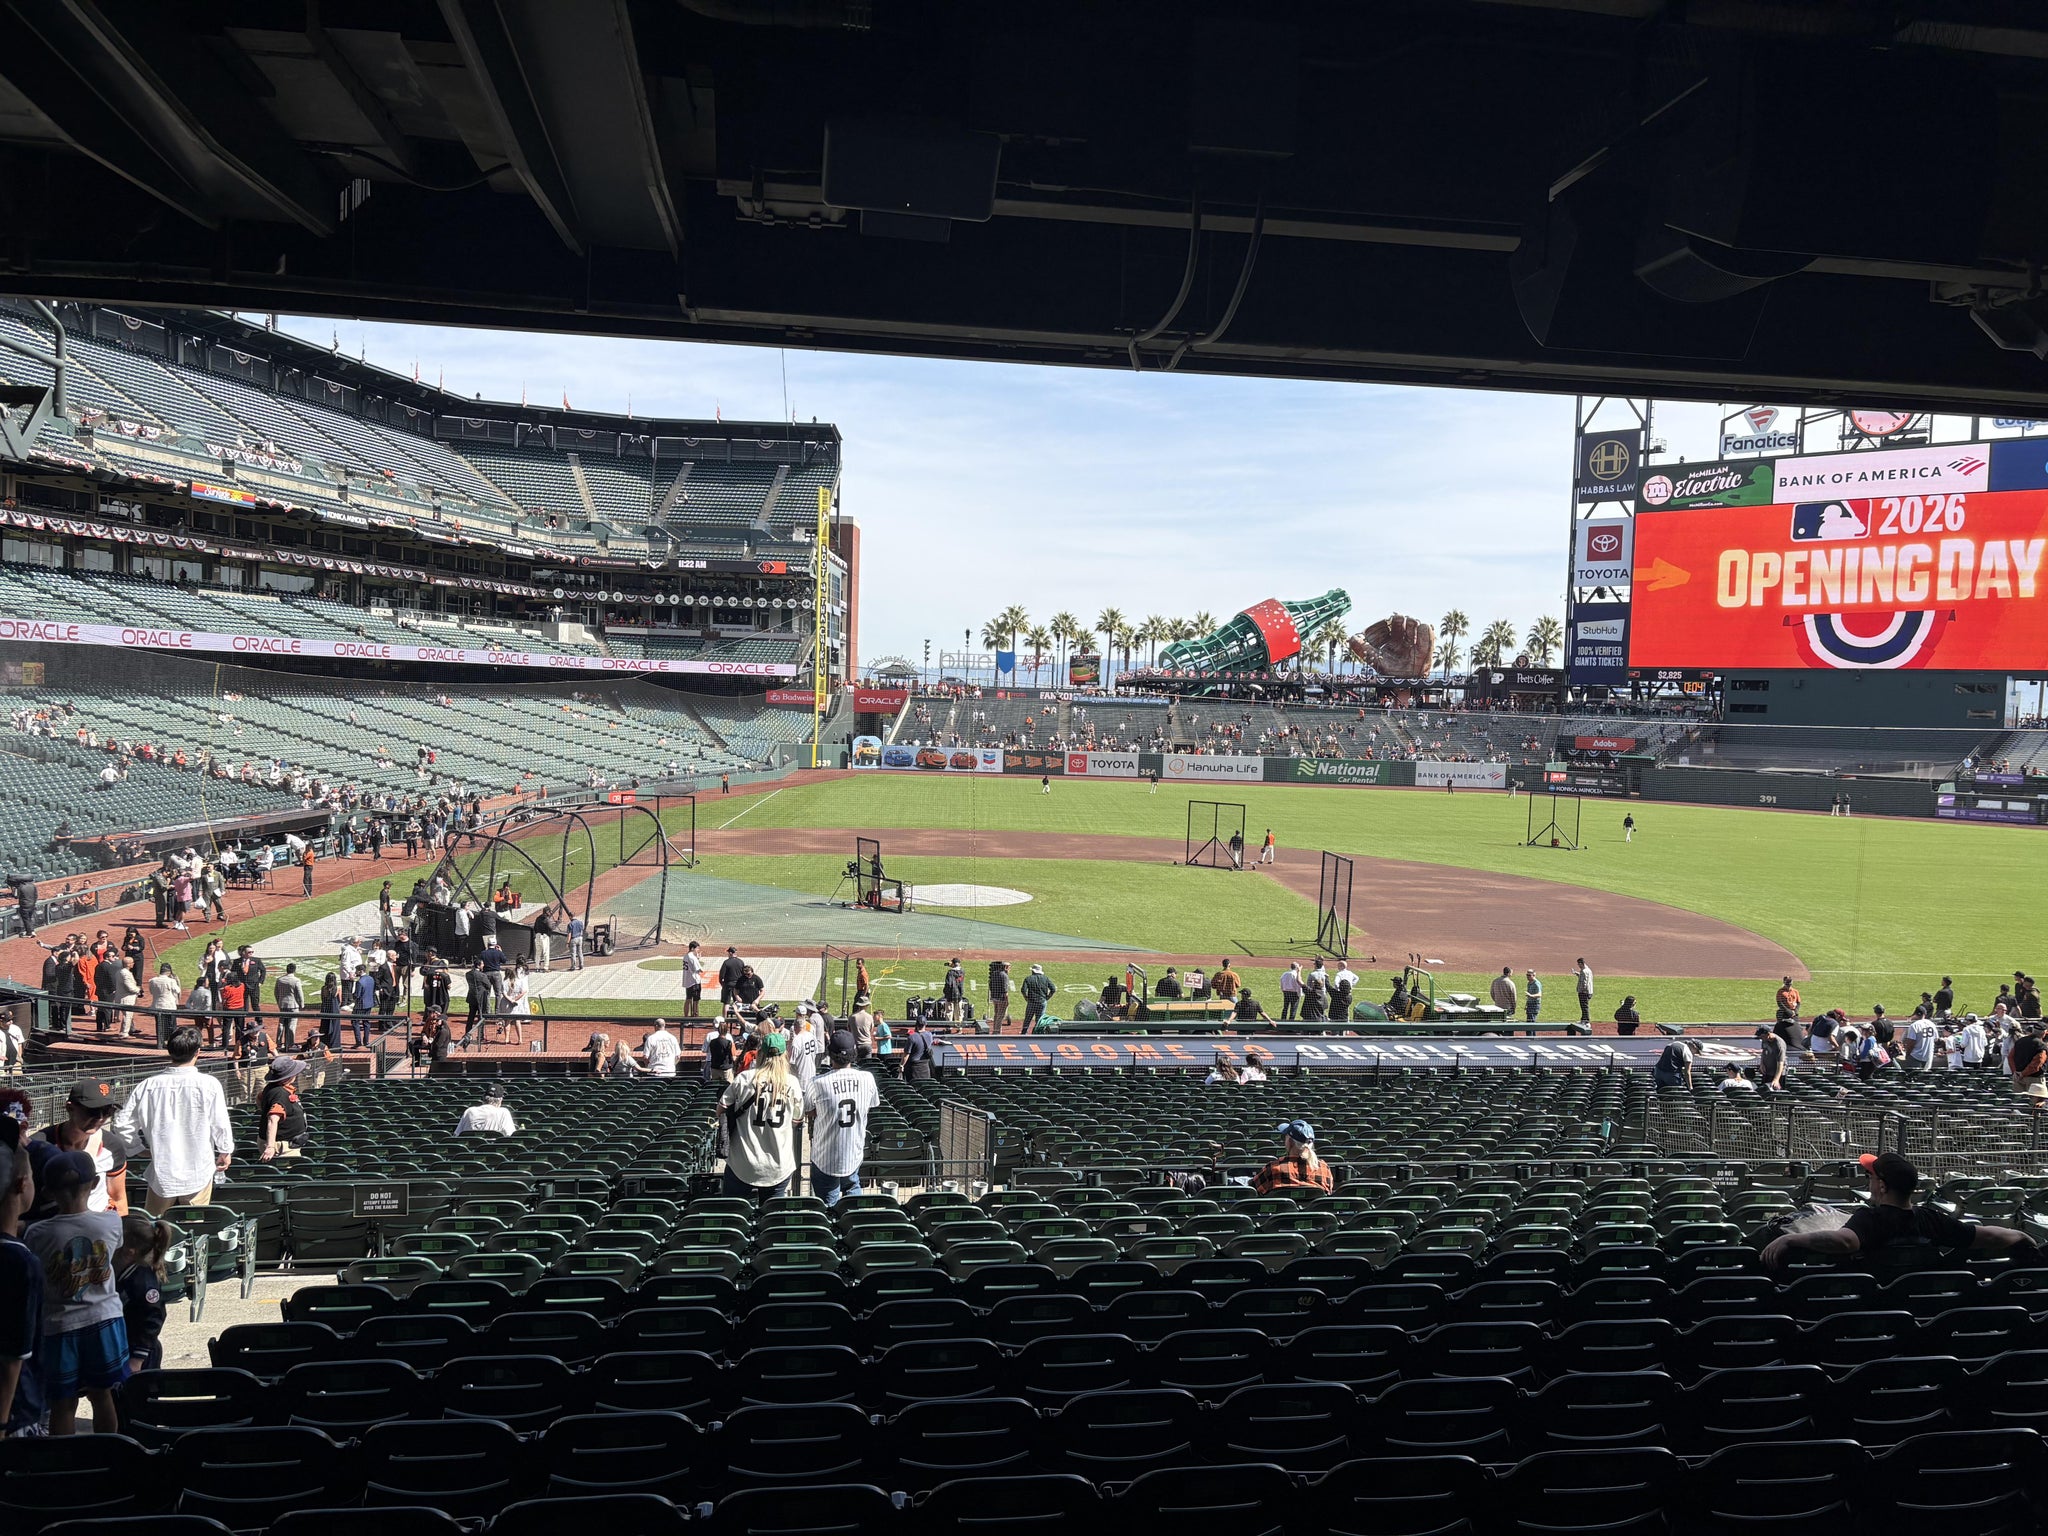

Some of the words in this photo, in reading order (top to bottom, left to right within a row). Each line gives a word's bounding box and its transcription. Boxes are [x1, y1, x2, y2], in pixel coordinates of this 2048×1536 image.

[1723, 433, 1795, 451] Fanatics
[1688, 466, 1729, 479] McMILLAN
[1779, 473, 1826, 487] BANK
[1831, 472, 1853, 484] OF
[1858, 466, 1942, 482] AMERICA
[1580, 484, 1615, 495] HABBAS
[1616, 483, 1636, 493] LAW
[1673, 471, 1743, 498] Electric
[1878, 494, 1966, 536] 2026
[695, 560, 707, 568] AM
[1577, 568, 1630, 580] TOYOTA
[1716, 543, 1933, 608] OPENING
[1937, 537, 2048, 600] DAY
[0, 621, 79, 641] ORACLE
[1583, 626, 1618, 635] StubHub
[121, 629, 192, 648] ORACLE
[233, 636, 301, 653] ORACLE
[334, 643, 391, 659] ORACLE
[417, 648, 465, 662] ORACLE
[1595, 646, 1622, 656] VERIFIED
[488, 652, 529, 665] ORACLE
[549, 655, 585, 668] ORACLE
[601, 659, 669, 671] ORACLE
[939, 650, 993, 669] blue
[1574, 657, 1597, 667] GIANTS
[1598, 656, 1624, 667] TICKETS
[708, 662, 775, 675] ORACLE
[1534, 674, 1554, 685] Coffee
[1657, 671, 1683, 680] $2,825
[782, 693, 816, 702] Budweise
[859, 697, 901, 705] ORACLE
[1593, 739, 1617, 748] Adobe
[1091, 760, 1135, 770] TOYOTA
[1187, 762, 1234, 773] Hanwha
[1236, 763, 1258, 774] Life
[1317, 761, 1380, 777] National
[1451, 773, 1486, 781] AMERICA
[1578, 787, 1603, 795] MINOLTA
[1759, 794, 1777, 804] 391
[804, 1040, 816, 1056] 99
[953, 1043, 1195, 1060] WELCOME
[1211, 1043, 1275, 1060] TO
[832, 1079, 860, 1094] RUTH
[753, 1098, 785, 1128] 13
[838, 1098, 857, 1128] 3
